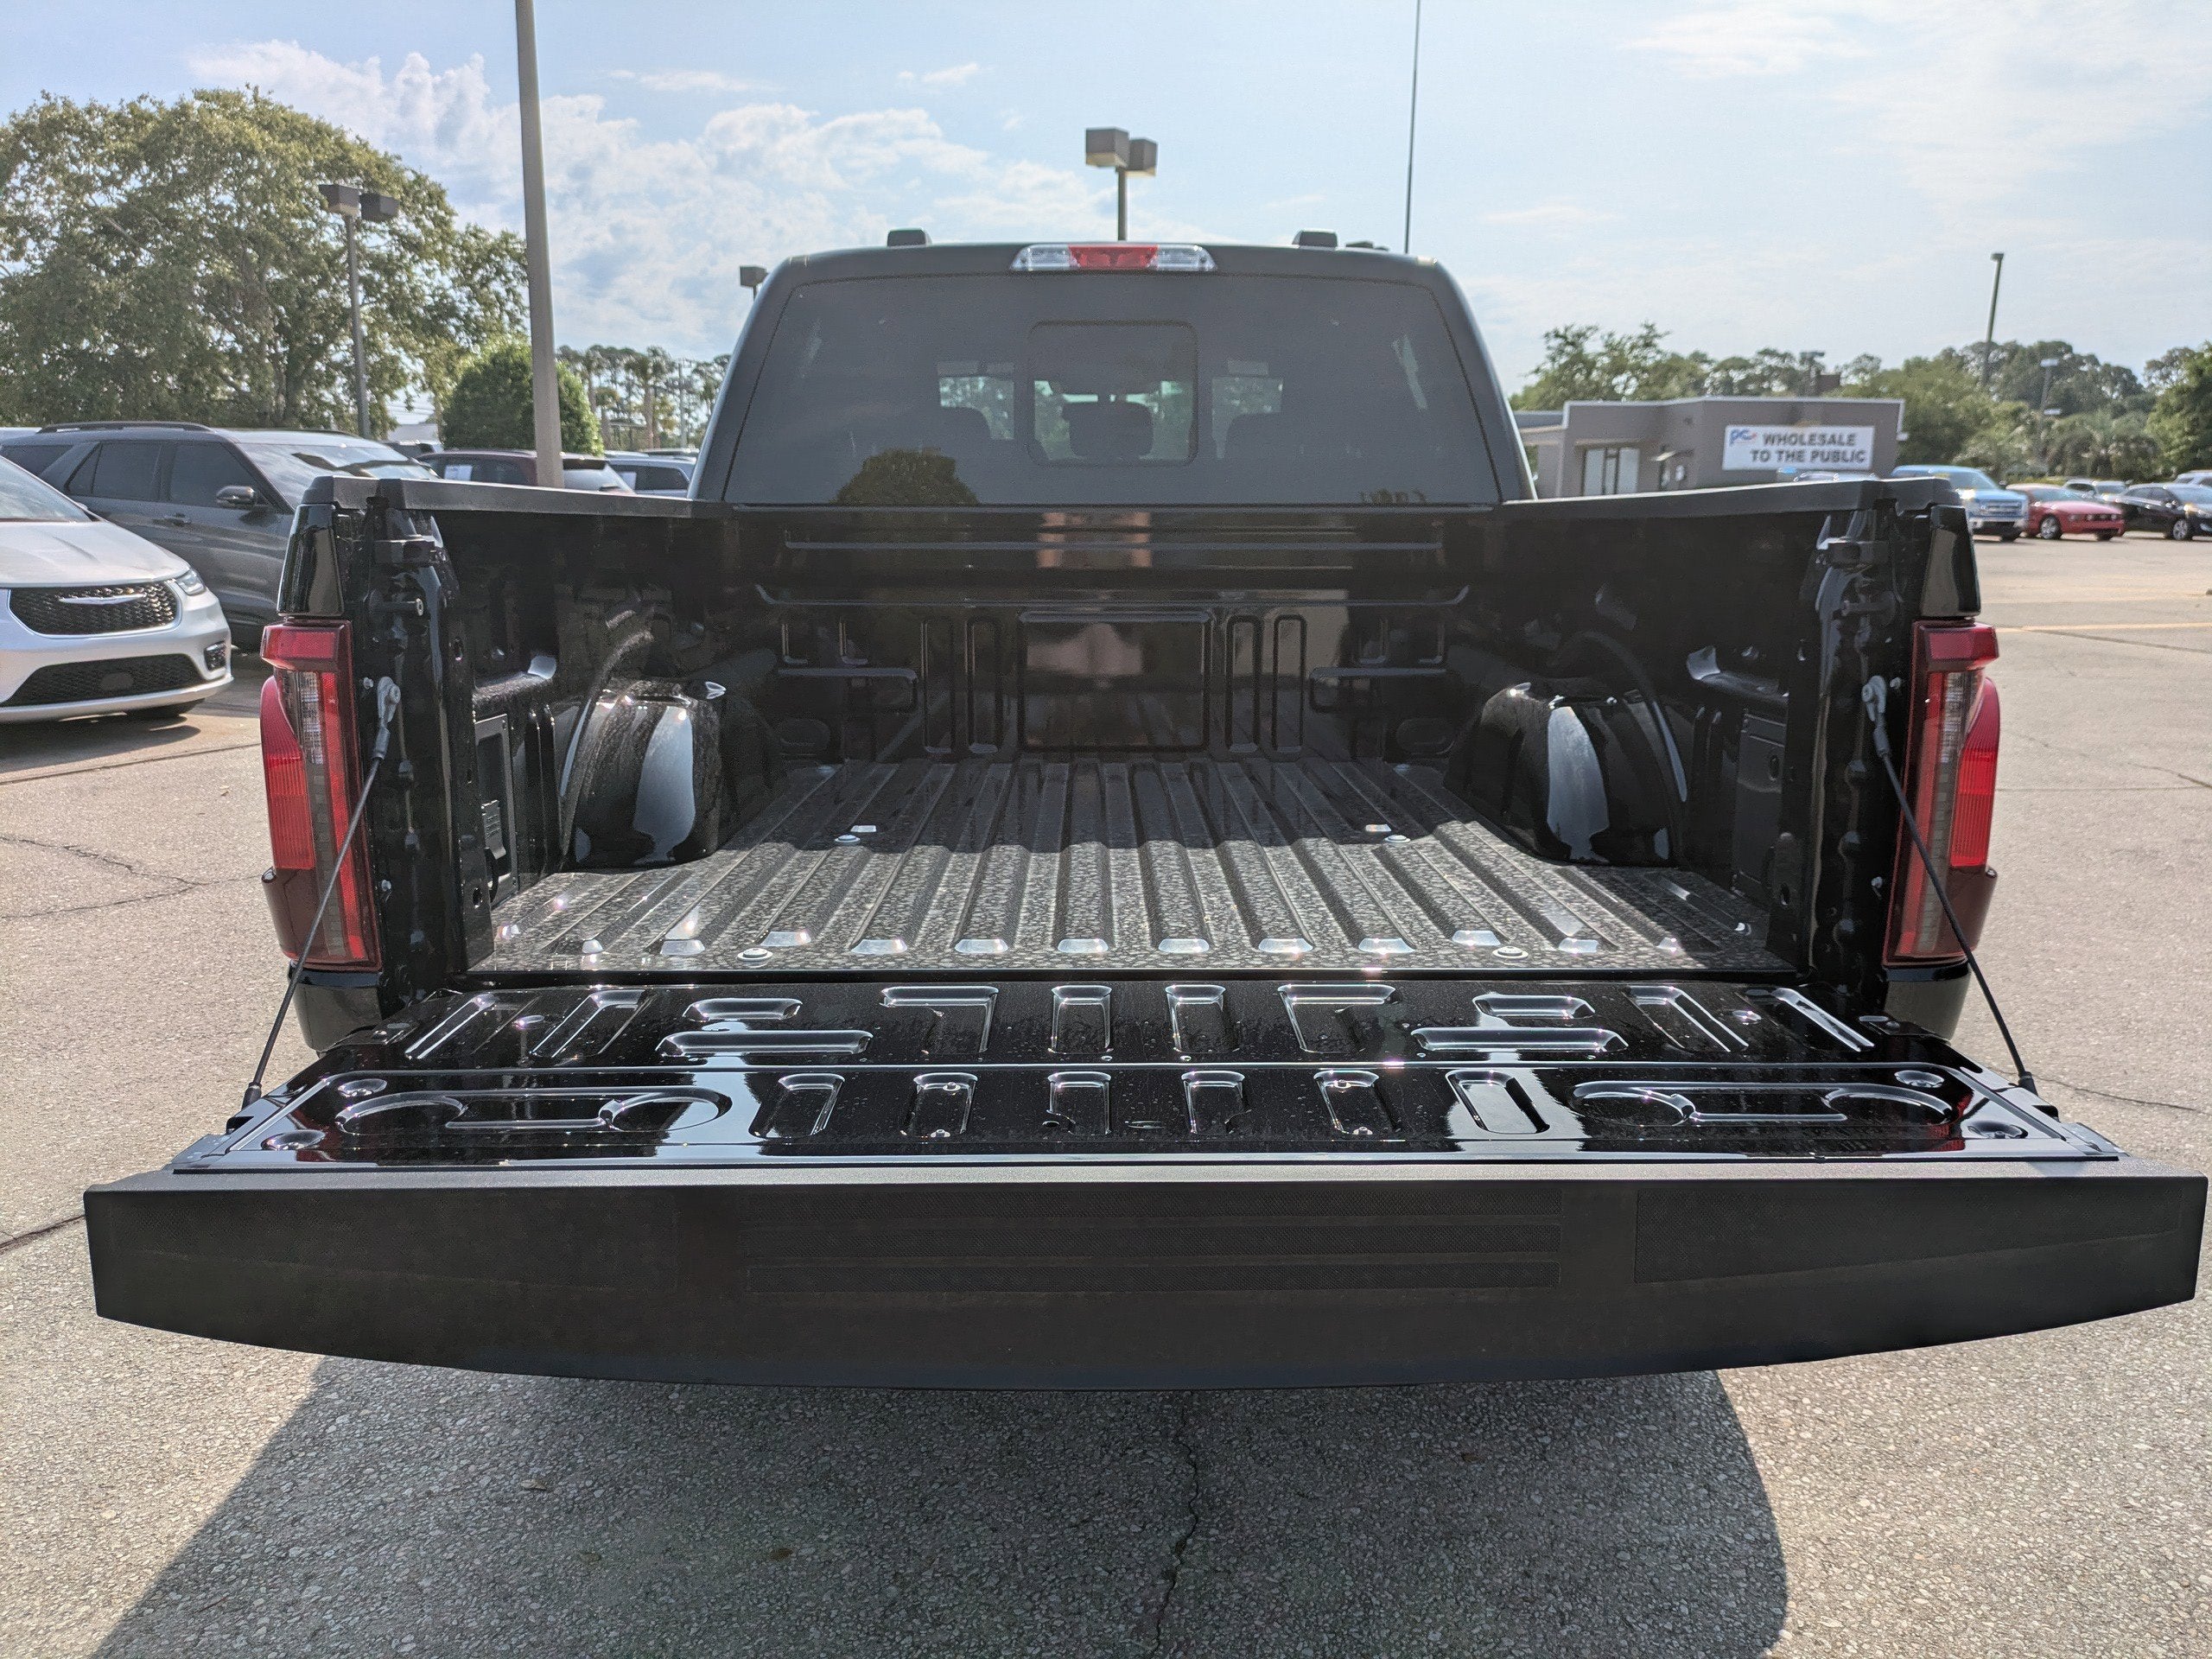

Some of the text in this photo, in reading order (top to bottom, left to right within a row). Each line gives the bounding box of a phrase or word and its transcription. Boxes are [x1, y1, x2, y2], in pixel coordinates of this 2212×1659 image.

[1763, 433, 1857, 446] WHOLESALE
[1751, 449, 1866, 463] TO THE PUBLIC
